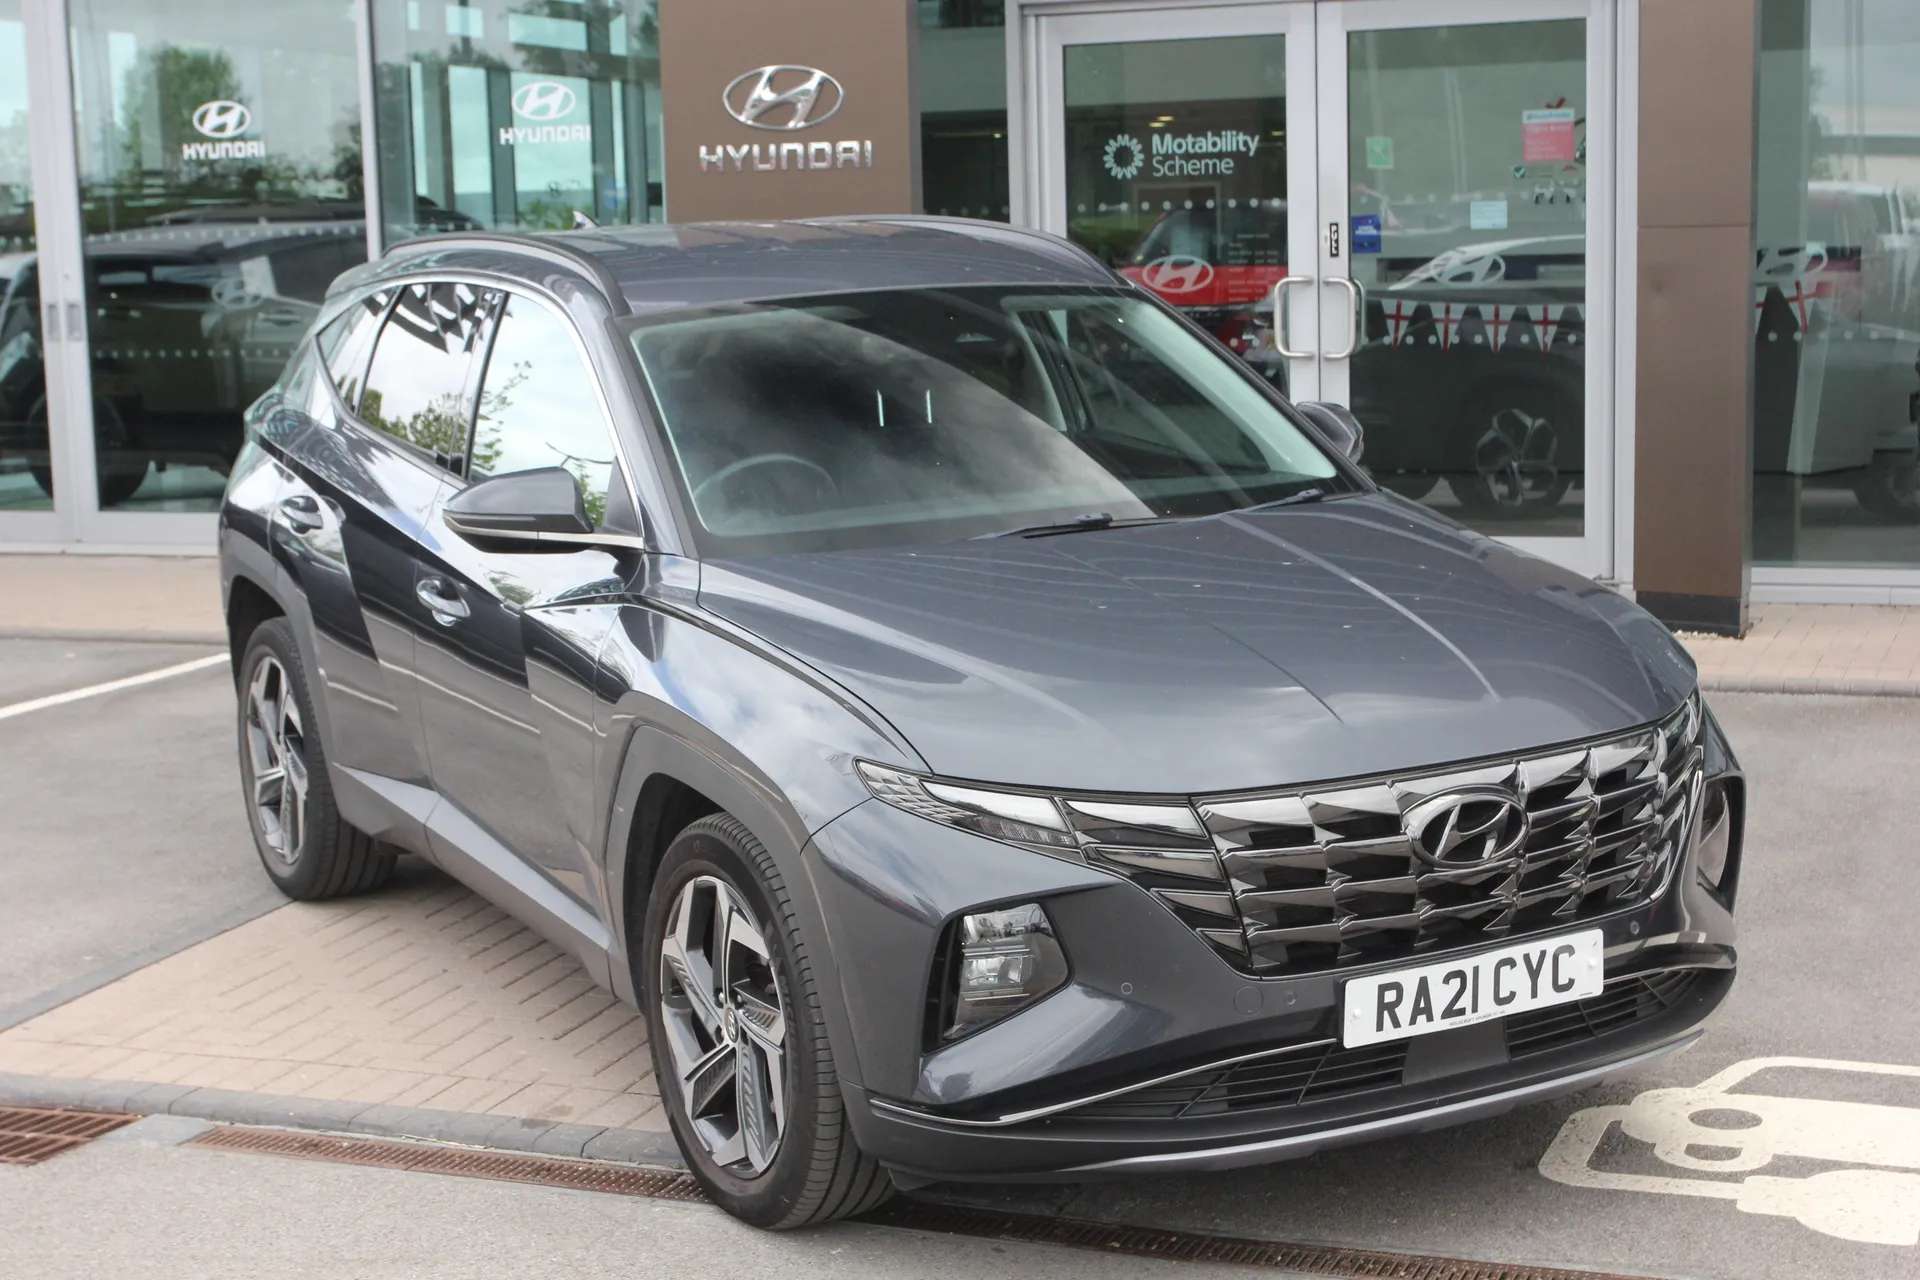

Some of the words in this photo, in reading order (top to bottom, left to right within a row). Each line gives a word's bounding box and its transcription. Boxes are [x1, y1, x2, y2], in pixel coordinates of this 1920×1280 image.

[500, 125, 591, 145] HYUNDAI
[1152, 130, 1260, 157] Motability
[182, 140, 265, 160] HYUNDAI
[699, 140, 872, 172] HYUNDAI
[1153, 156, 1234, 177] Scheme
[1376, 965, 1480, 1032] RA21
[1493, 944, 1576, 1006] CYC
